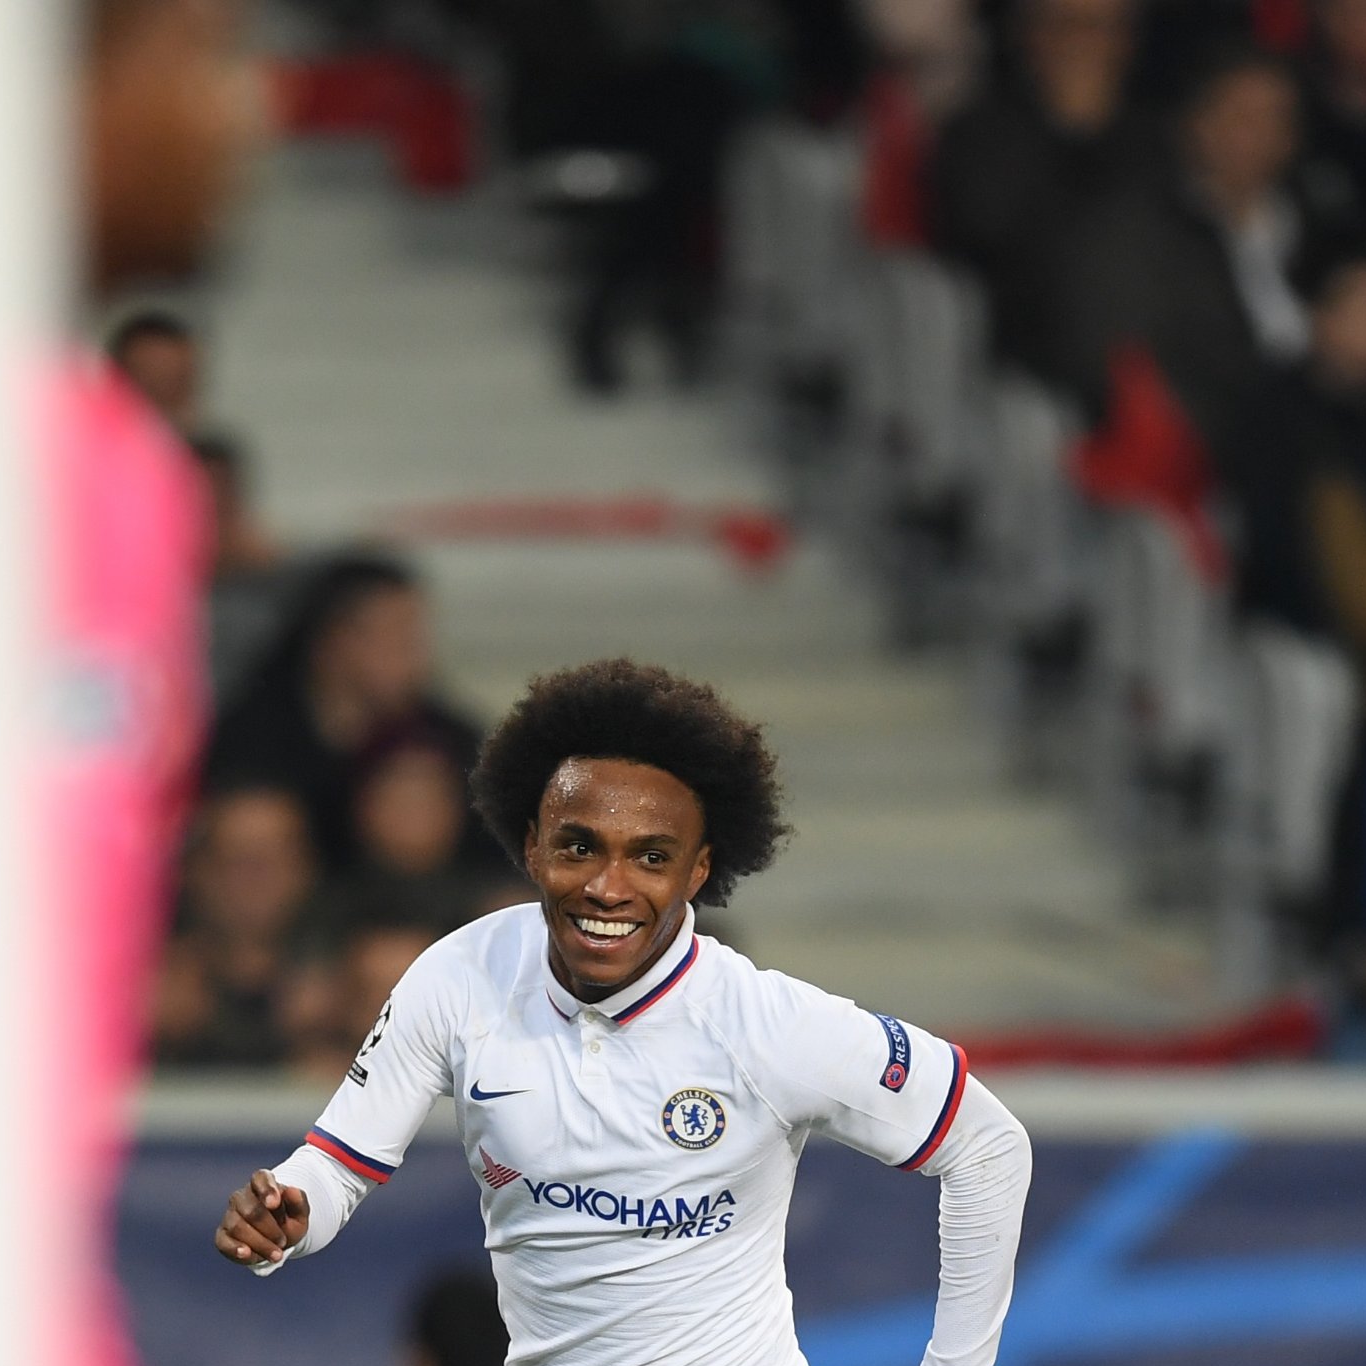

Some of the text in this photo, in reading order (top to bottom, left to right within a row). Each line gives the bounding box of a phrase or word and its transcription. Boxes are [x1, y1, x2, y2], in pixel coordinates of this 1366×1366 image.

[670, 1090, 712, 1106] CHELSEA
[675, 1137, 704, 1148] FOOTBALL
[523, 1177, 736, 1227] YOKOHAMA
